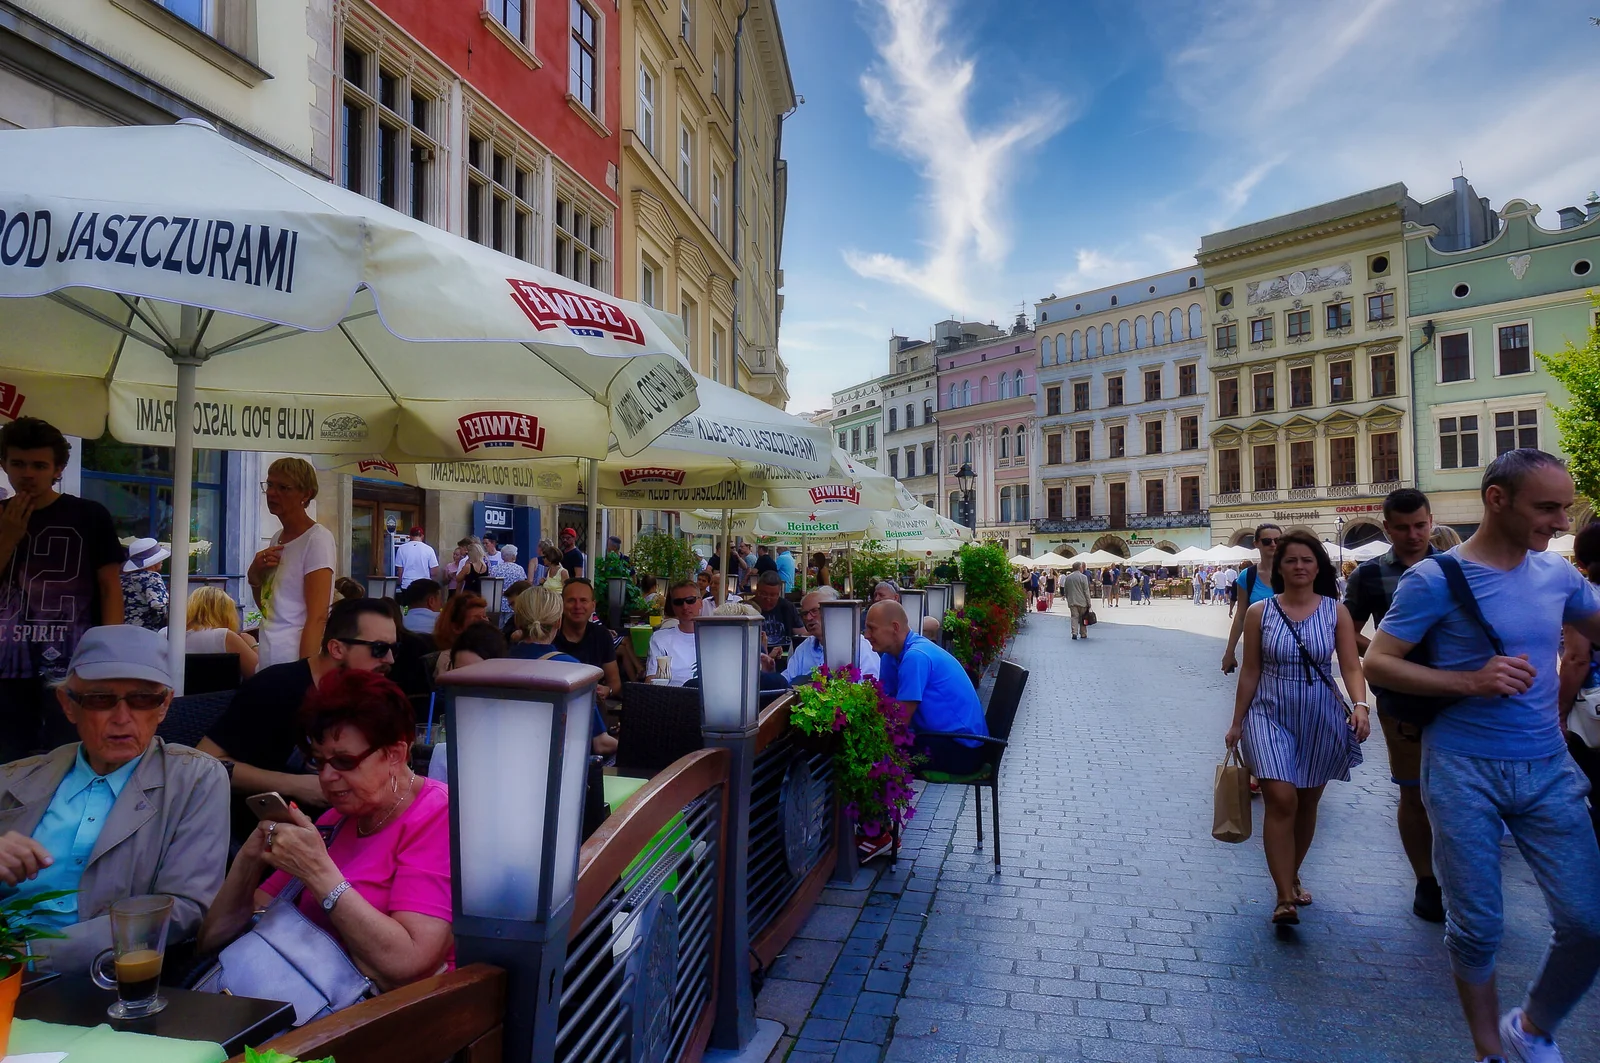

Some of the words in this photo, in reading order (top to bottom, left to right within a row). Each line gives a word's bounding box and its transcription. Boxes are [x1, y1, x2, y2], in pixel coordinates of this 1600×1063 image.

[56, 210, 299, 294] JASZCZURAMI
[519, 281, 623, 327] ŻYWIEC
[694, 415, 727, 443] KLUB
[724, 424, 751, 448] POD
[749, 428, 819, 462] JASZCZURAMI
[1336, 505, 1366, 513] GRANDE
[787, 521, 840, 531] Heineken
[885, 530, 923, 538] Heineken
[13, 624, 68, 642] SPIRIT
